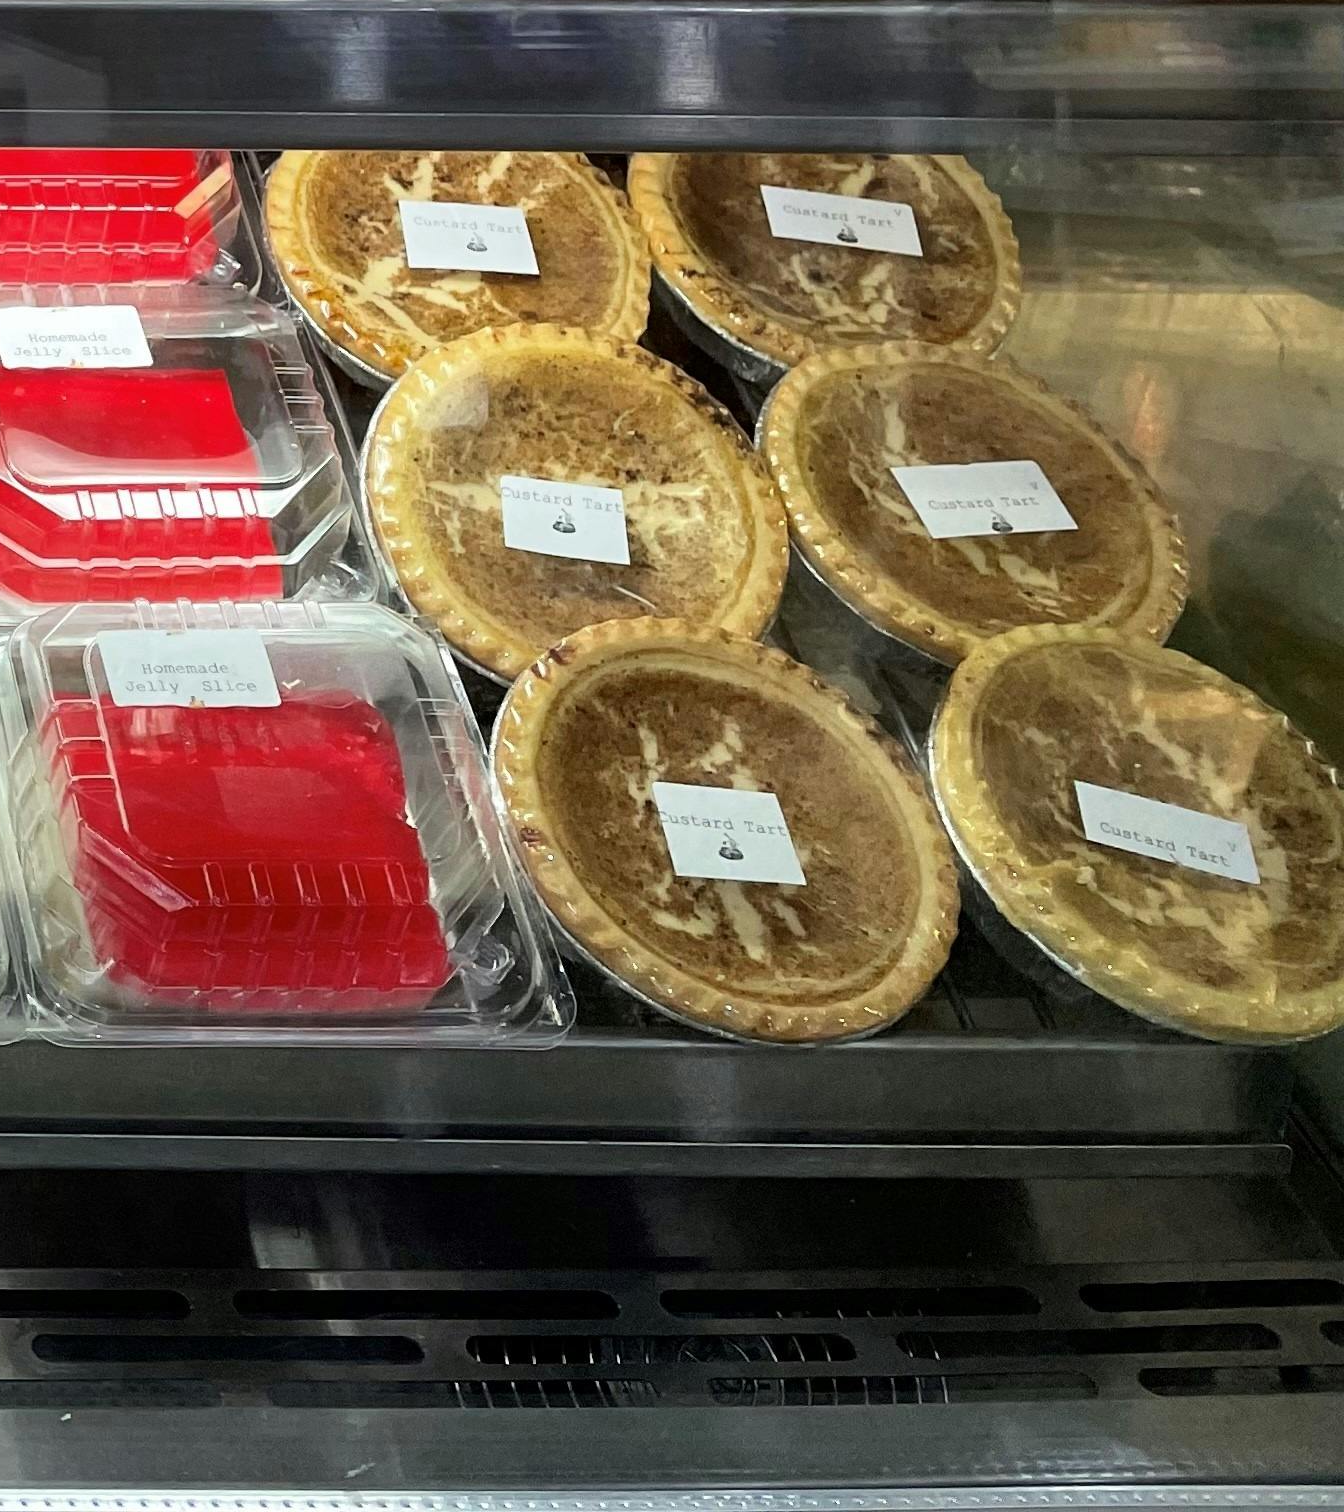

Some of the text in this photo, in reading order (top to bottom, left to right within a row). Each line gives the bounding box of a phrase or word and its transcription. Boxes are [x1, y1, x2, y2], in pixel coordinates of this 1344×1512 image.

[14, 347, 62, 357] Jelly
[501, 486, 623, 514] Custard Tart
[999, 496, 1041, 507] Tart
[141, 662, 229, 675] Homemade
[125, 680, 257, 694] Jelly Slice
[658, 810, 788, 836] Custard Tart
[1099, 821, 1231, 868] Custard Tart
